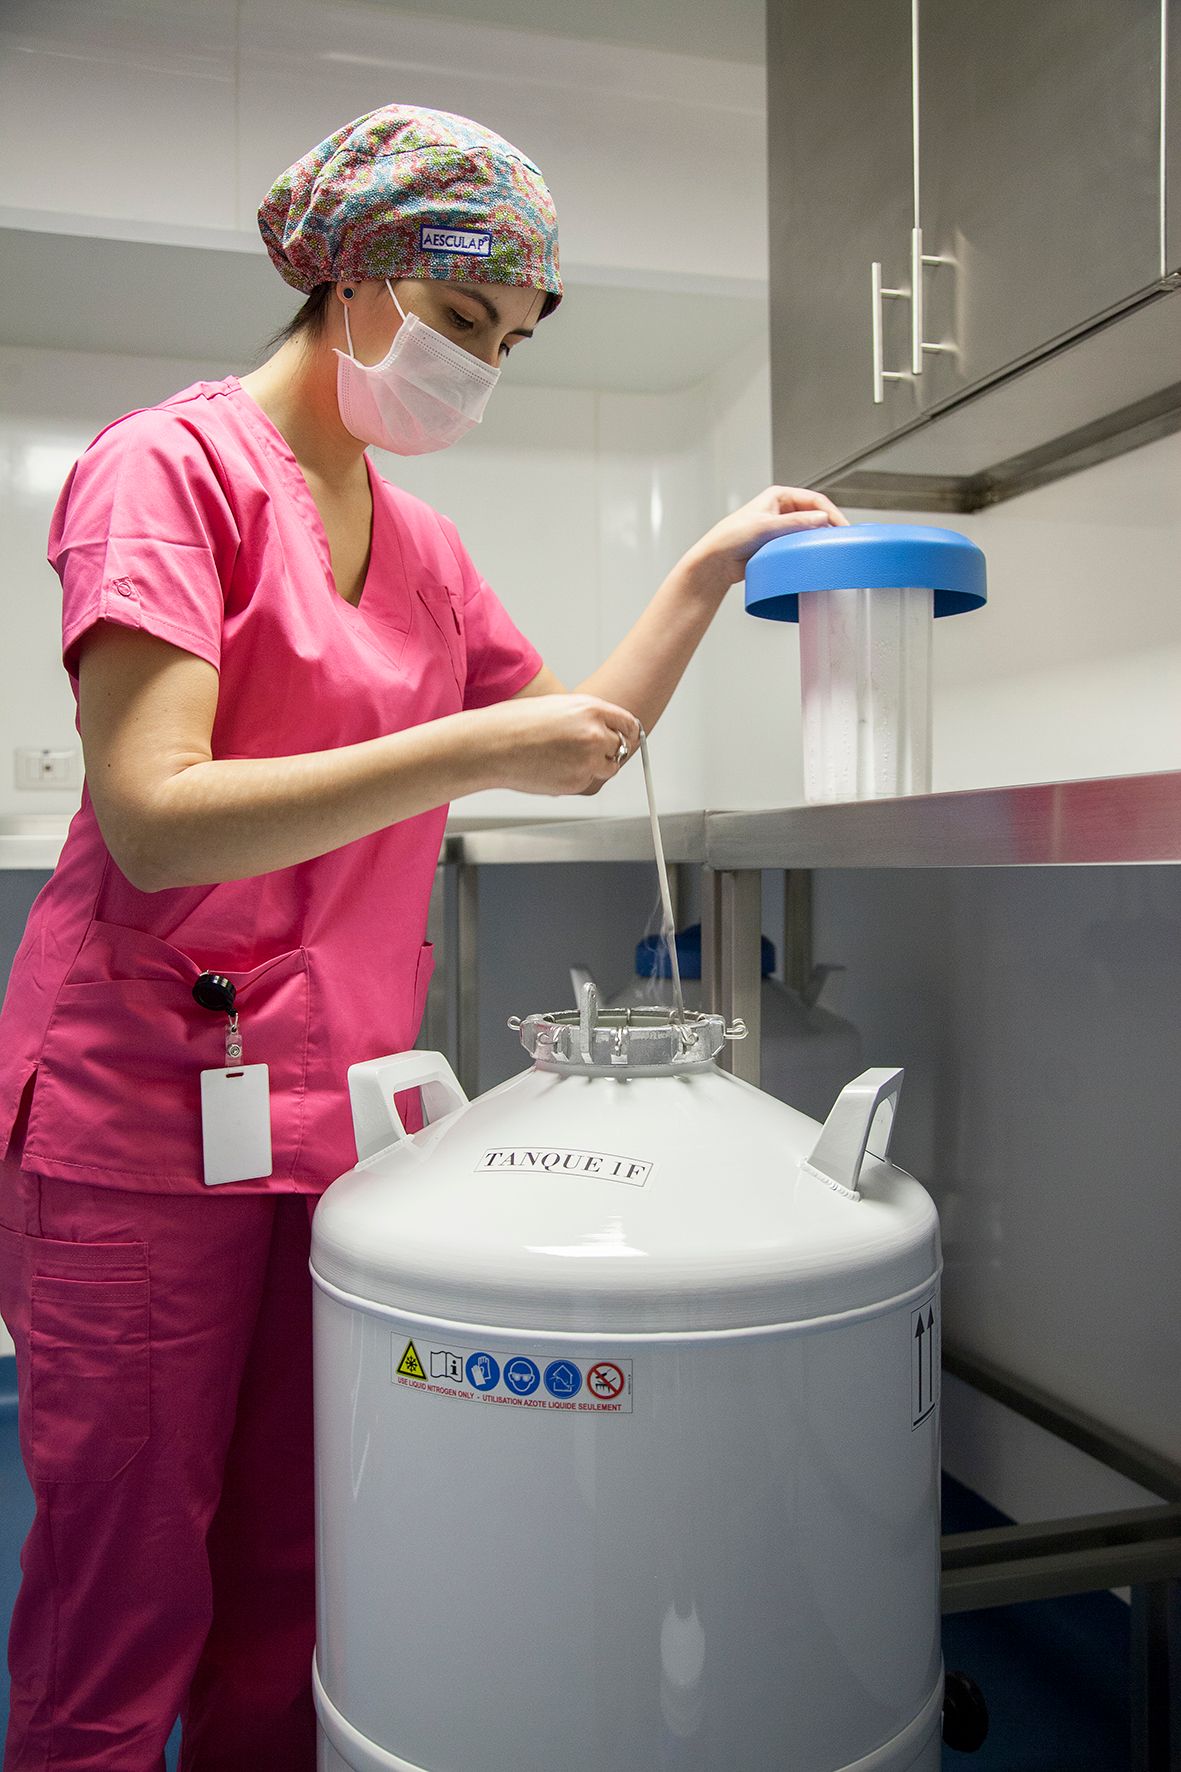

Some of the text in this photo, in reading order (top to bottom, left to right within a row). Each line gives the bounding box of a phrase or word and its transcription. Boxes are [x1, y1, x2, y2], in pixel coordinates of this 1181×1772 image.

[484, 1152, 603, 1173] TANQUE
[398, 1377, 408, 1386] USE
[408, 1380, 427, 1391] LIQUID
[427, 1385, 457, 1397] NITROGEN
[458, 1390, 475, 1400] ONLY
[482, 1394, 523, 1407] UTILISATION
[523, 1399, 547, 1409] AZOTE
[547, 1401, 577, 1410] LIQUIDE
[577, 1403, 623, 1412] SEULEMENT
